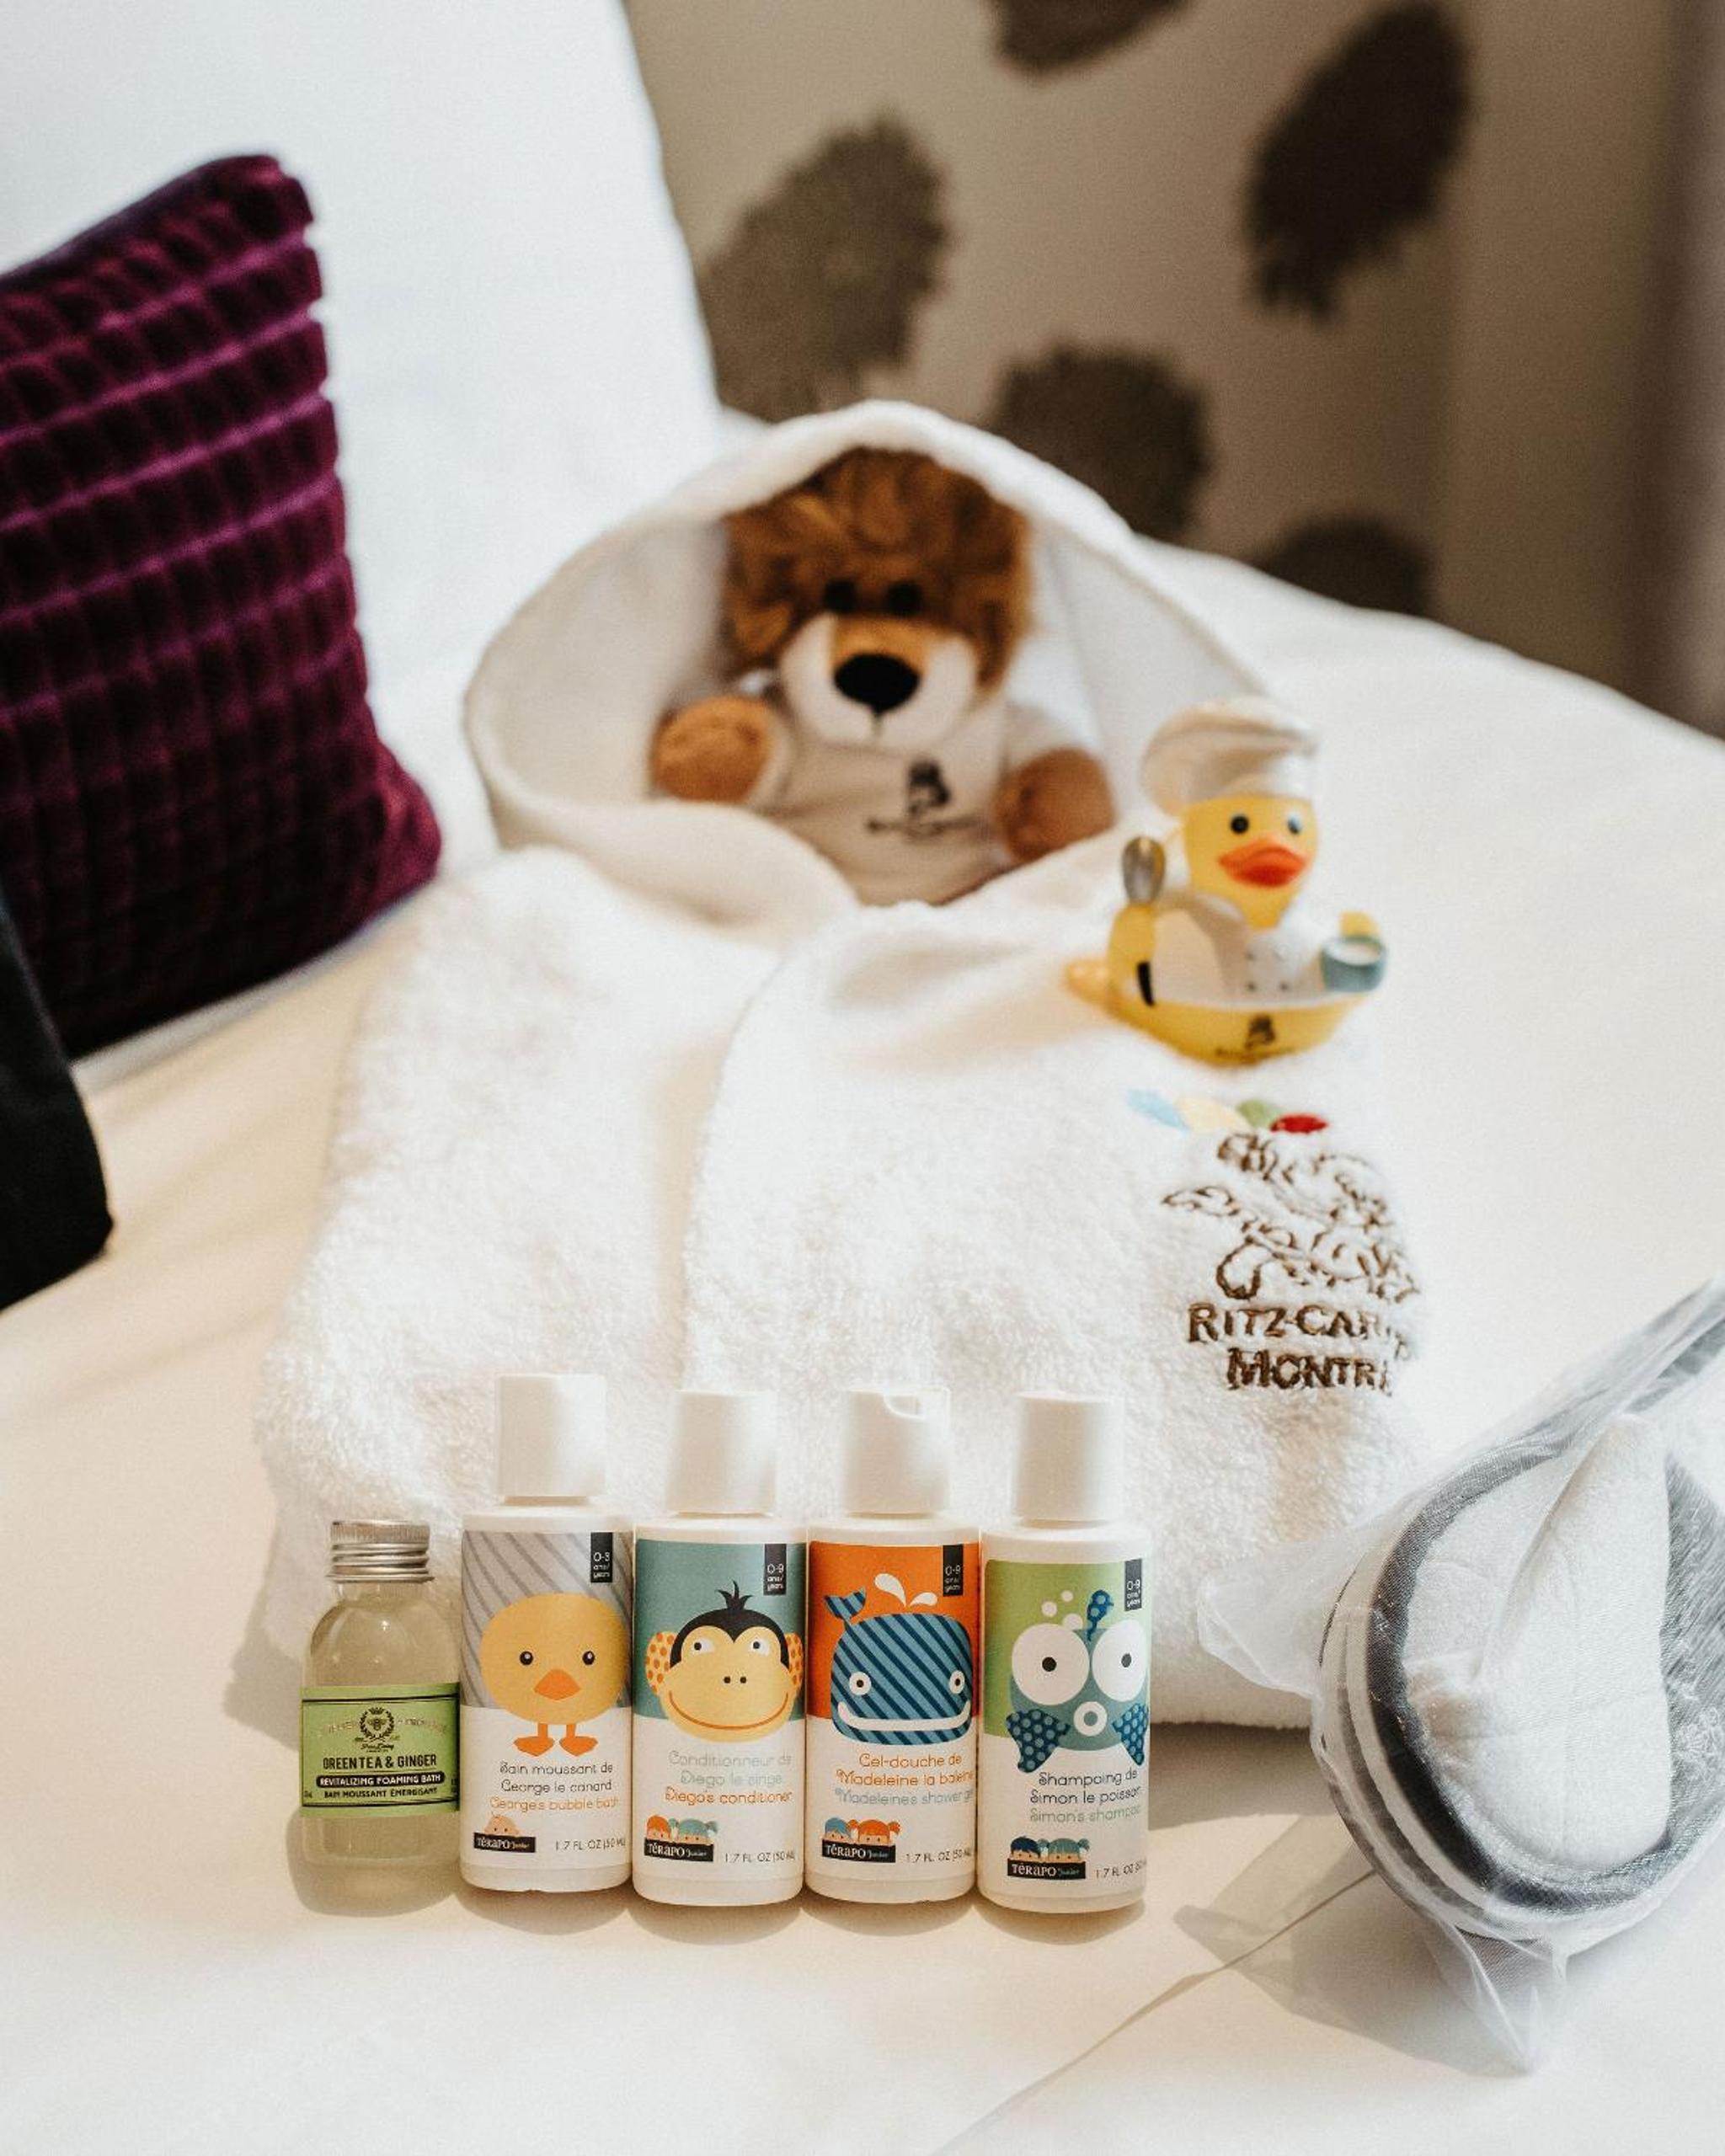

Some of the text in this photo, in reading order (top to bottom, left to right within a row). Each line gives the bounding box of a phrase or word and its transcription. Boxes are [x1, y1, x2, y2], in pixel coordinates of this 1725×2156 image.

[358, 1756, 382, 1769] TEA
[385, 1755, 394, 1768] &
[398, 1754, 436, 1768] GINGER
[531, 1765, 597, 1775] moussant
[600, 1762, 613, 1774] de
[859, 1753, 962, 1768] Gel-douche de
[421, 1774, 441, 1783] BATH
[681, 1769, 725, 1789] Diego
[1039, 1766, 1137, 1787] Shampoing de
[500, 1779, 612, 1796] George le canard
[1030, 1788, 1078, 1805] Simon
[1083, 1791, 1095, 1803] le
